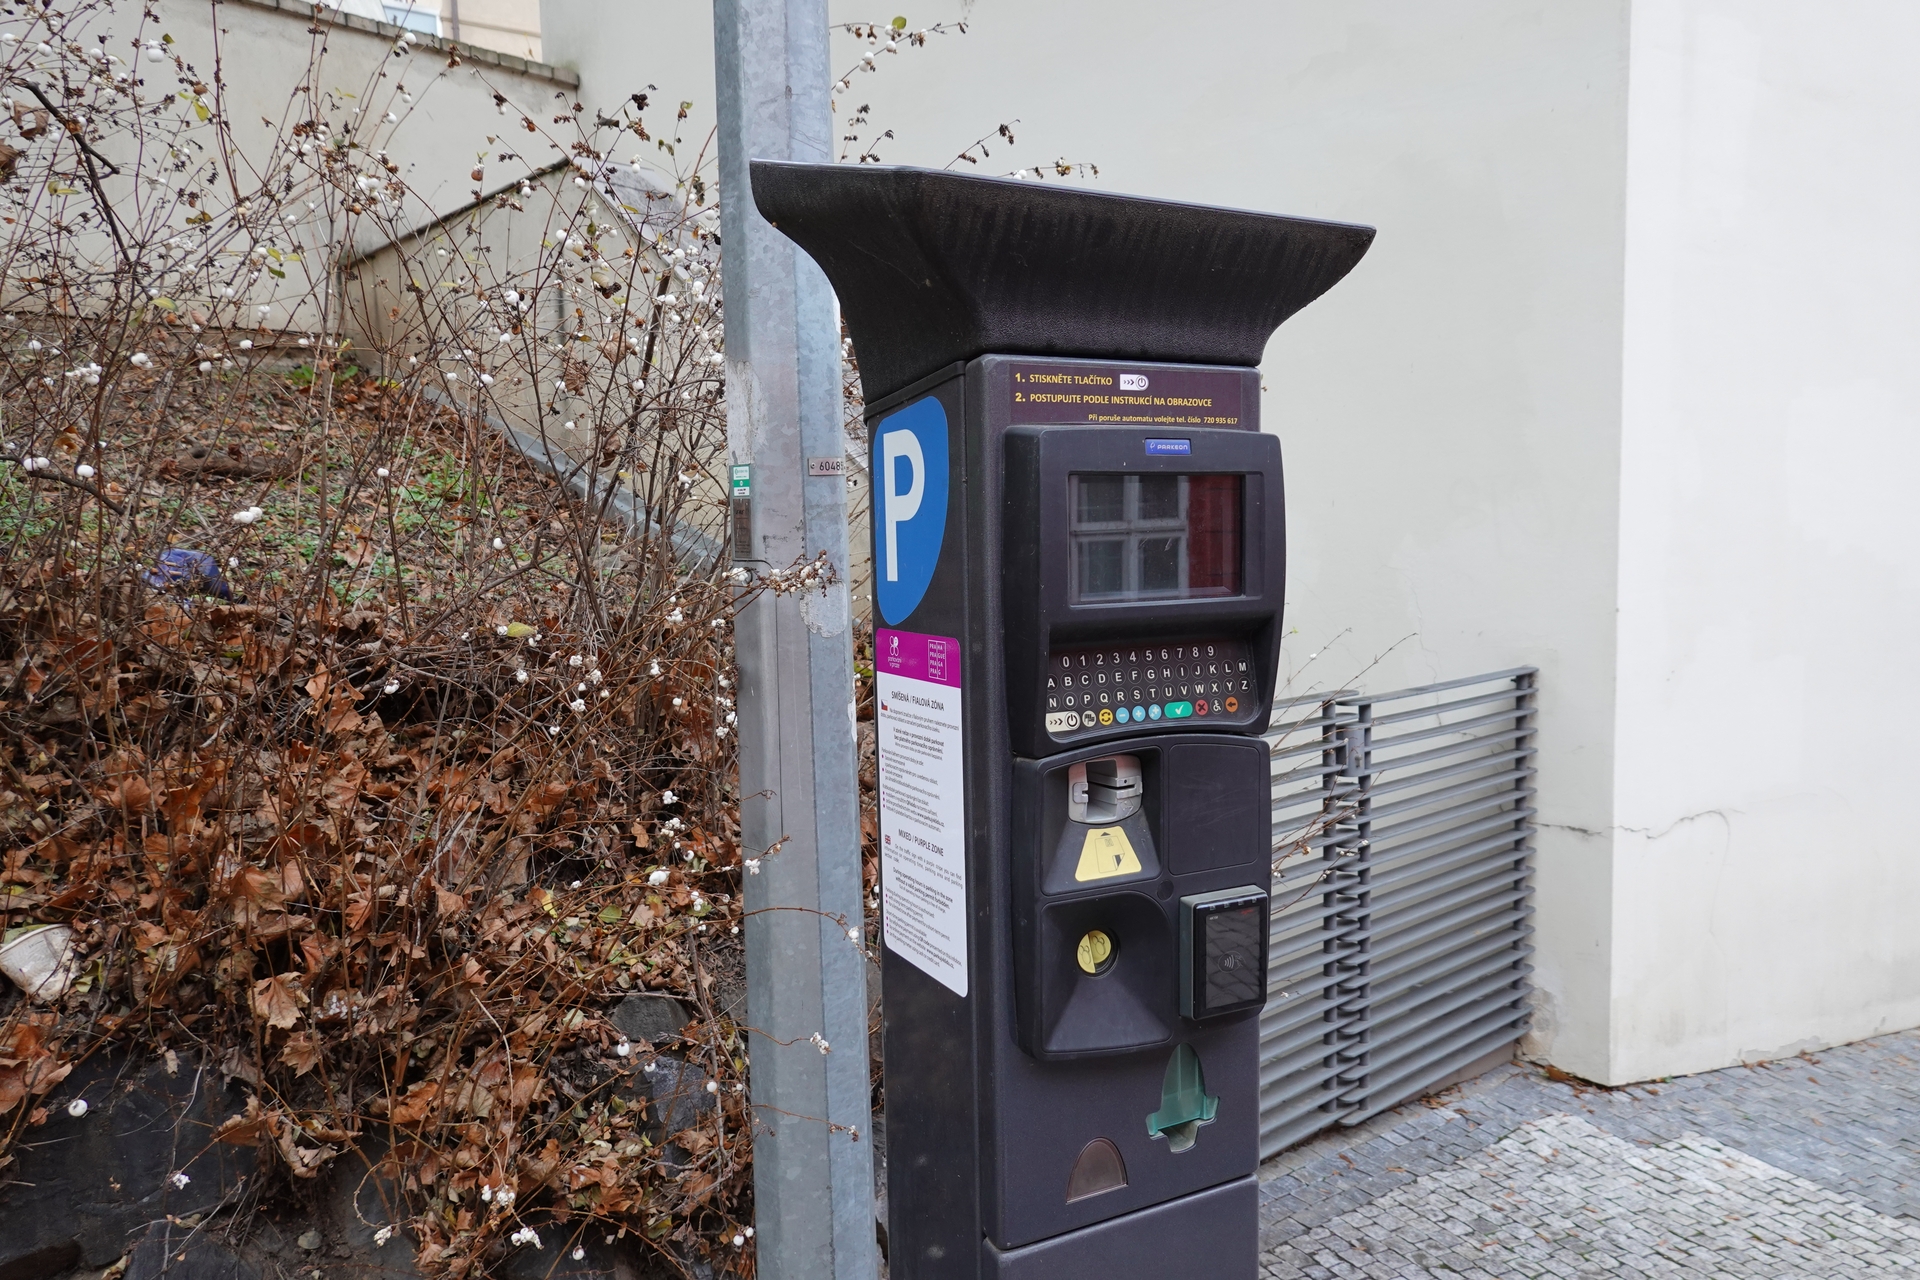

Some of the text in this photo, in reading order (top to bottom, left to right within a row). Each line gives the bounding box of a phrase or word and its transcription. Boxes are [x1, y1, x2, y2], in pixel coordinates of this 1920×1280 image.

[1015, 372, 1112, 385] 1. STISKNĚTE TLAČÍTKO
[1015, 392, 1026, 402] 2.
[1030, 394, 1081, 403] POSTUPUJTE
[1084, 396, 1109, 404] PODLE
[1112, 395, 1152, 405] INSTRUKCÍ
[1167, 398, 1212, 407] OBRAZOVCE
[1099, 414, 1121, 422] poruše
[883, 429, 925, 581] P
[1062, 646, 1214, 667] 0 1 2 3 4 5 6 7 8 9
[1047, 662, 1247, 688] A B C D E F G H I J K L M
[1050, 680, 1248, 707] N O P Q R S T U V W X Y Z
[915, 836, 930, 850] PURPLE
[932, 844, 944, 856] ZONE
